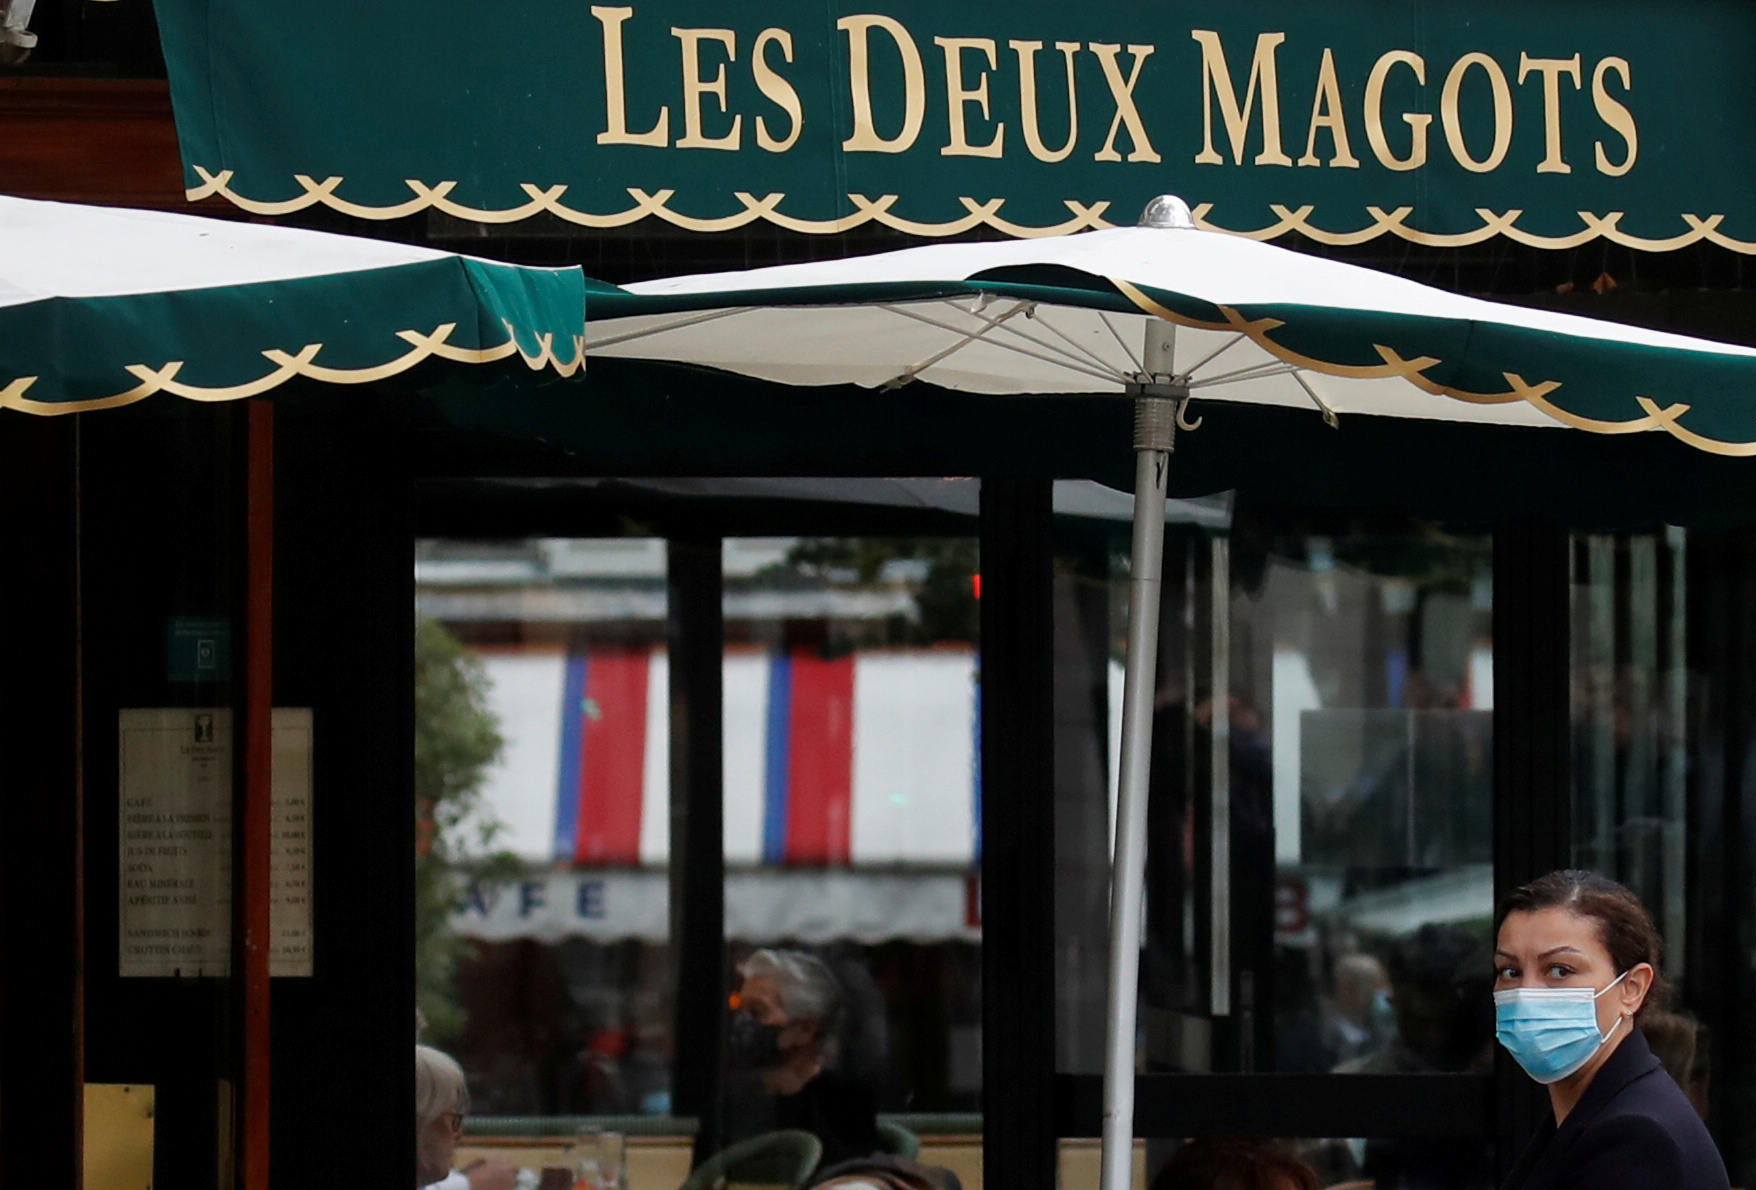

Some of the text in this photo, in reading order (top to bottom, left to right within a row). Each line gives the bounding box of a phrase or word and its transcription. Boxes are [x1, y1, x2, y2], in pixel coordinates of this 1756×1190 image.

[591, 5, 1638, 177] LES DEUX MAGOTS
